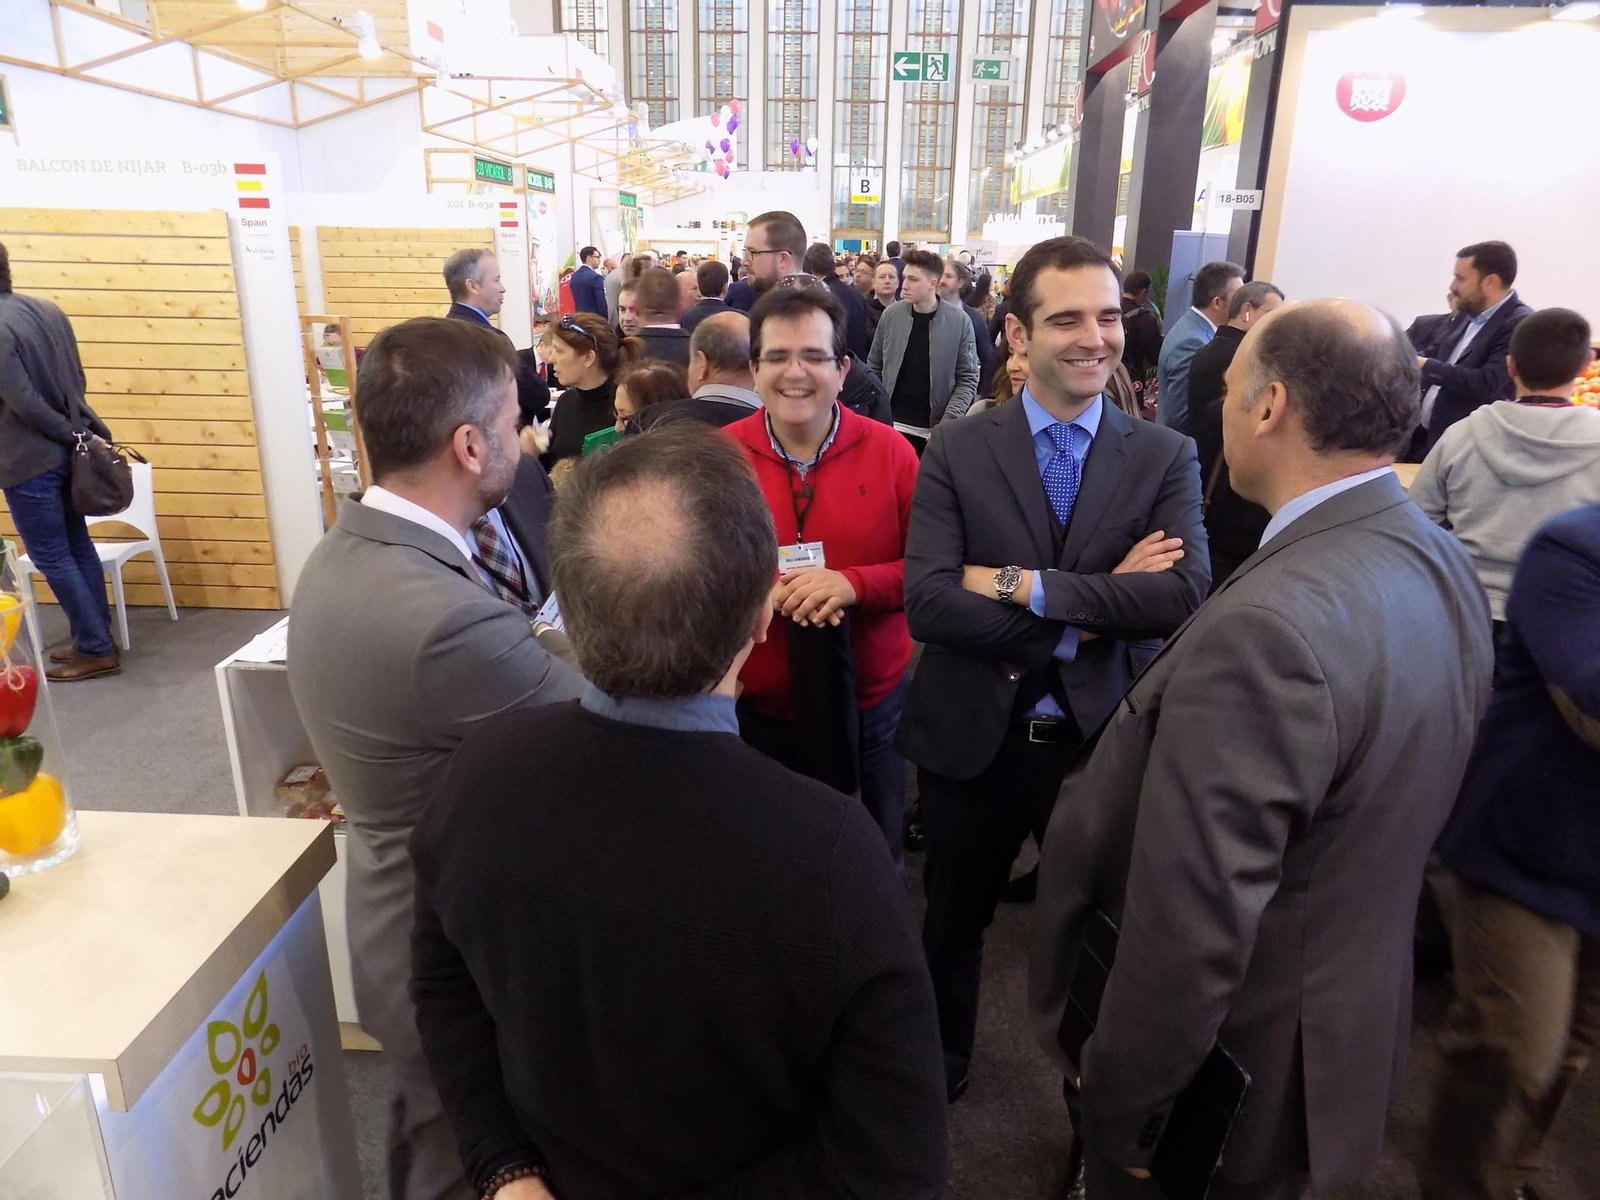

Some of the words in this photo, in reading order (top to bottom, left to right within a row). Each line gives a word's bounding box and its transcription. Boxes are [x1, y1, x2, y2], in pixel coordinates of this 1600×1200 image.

[16, 158, 86, 173] BALCON
[91, 159, 113, 173] DE
[117, 160, 167, 176] NIJAR
[181, 159, 227, 176] B-03b
[860, 179, 870, 194] B
[1220, 194, 1255, 204] 18-B05
[241, 217, 268, 229] Spain
